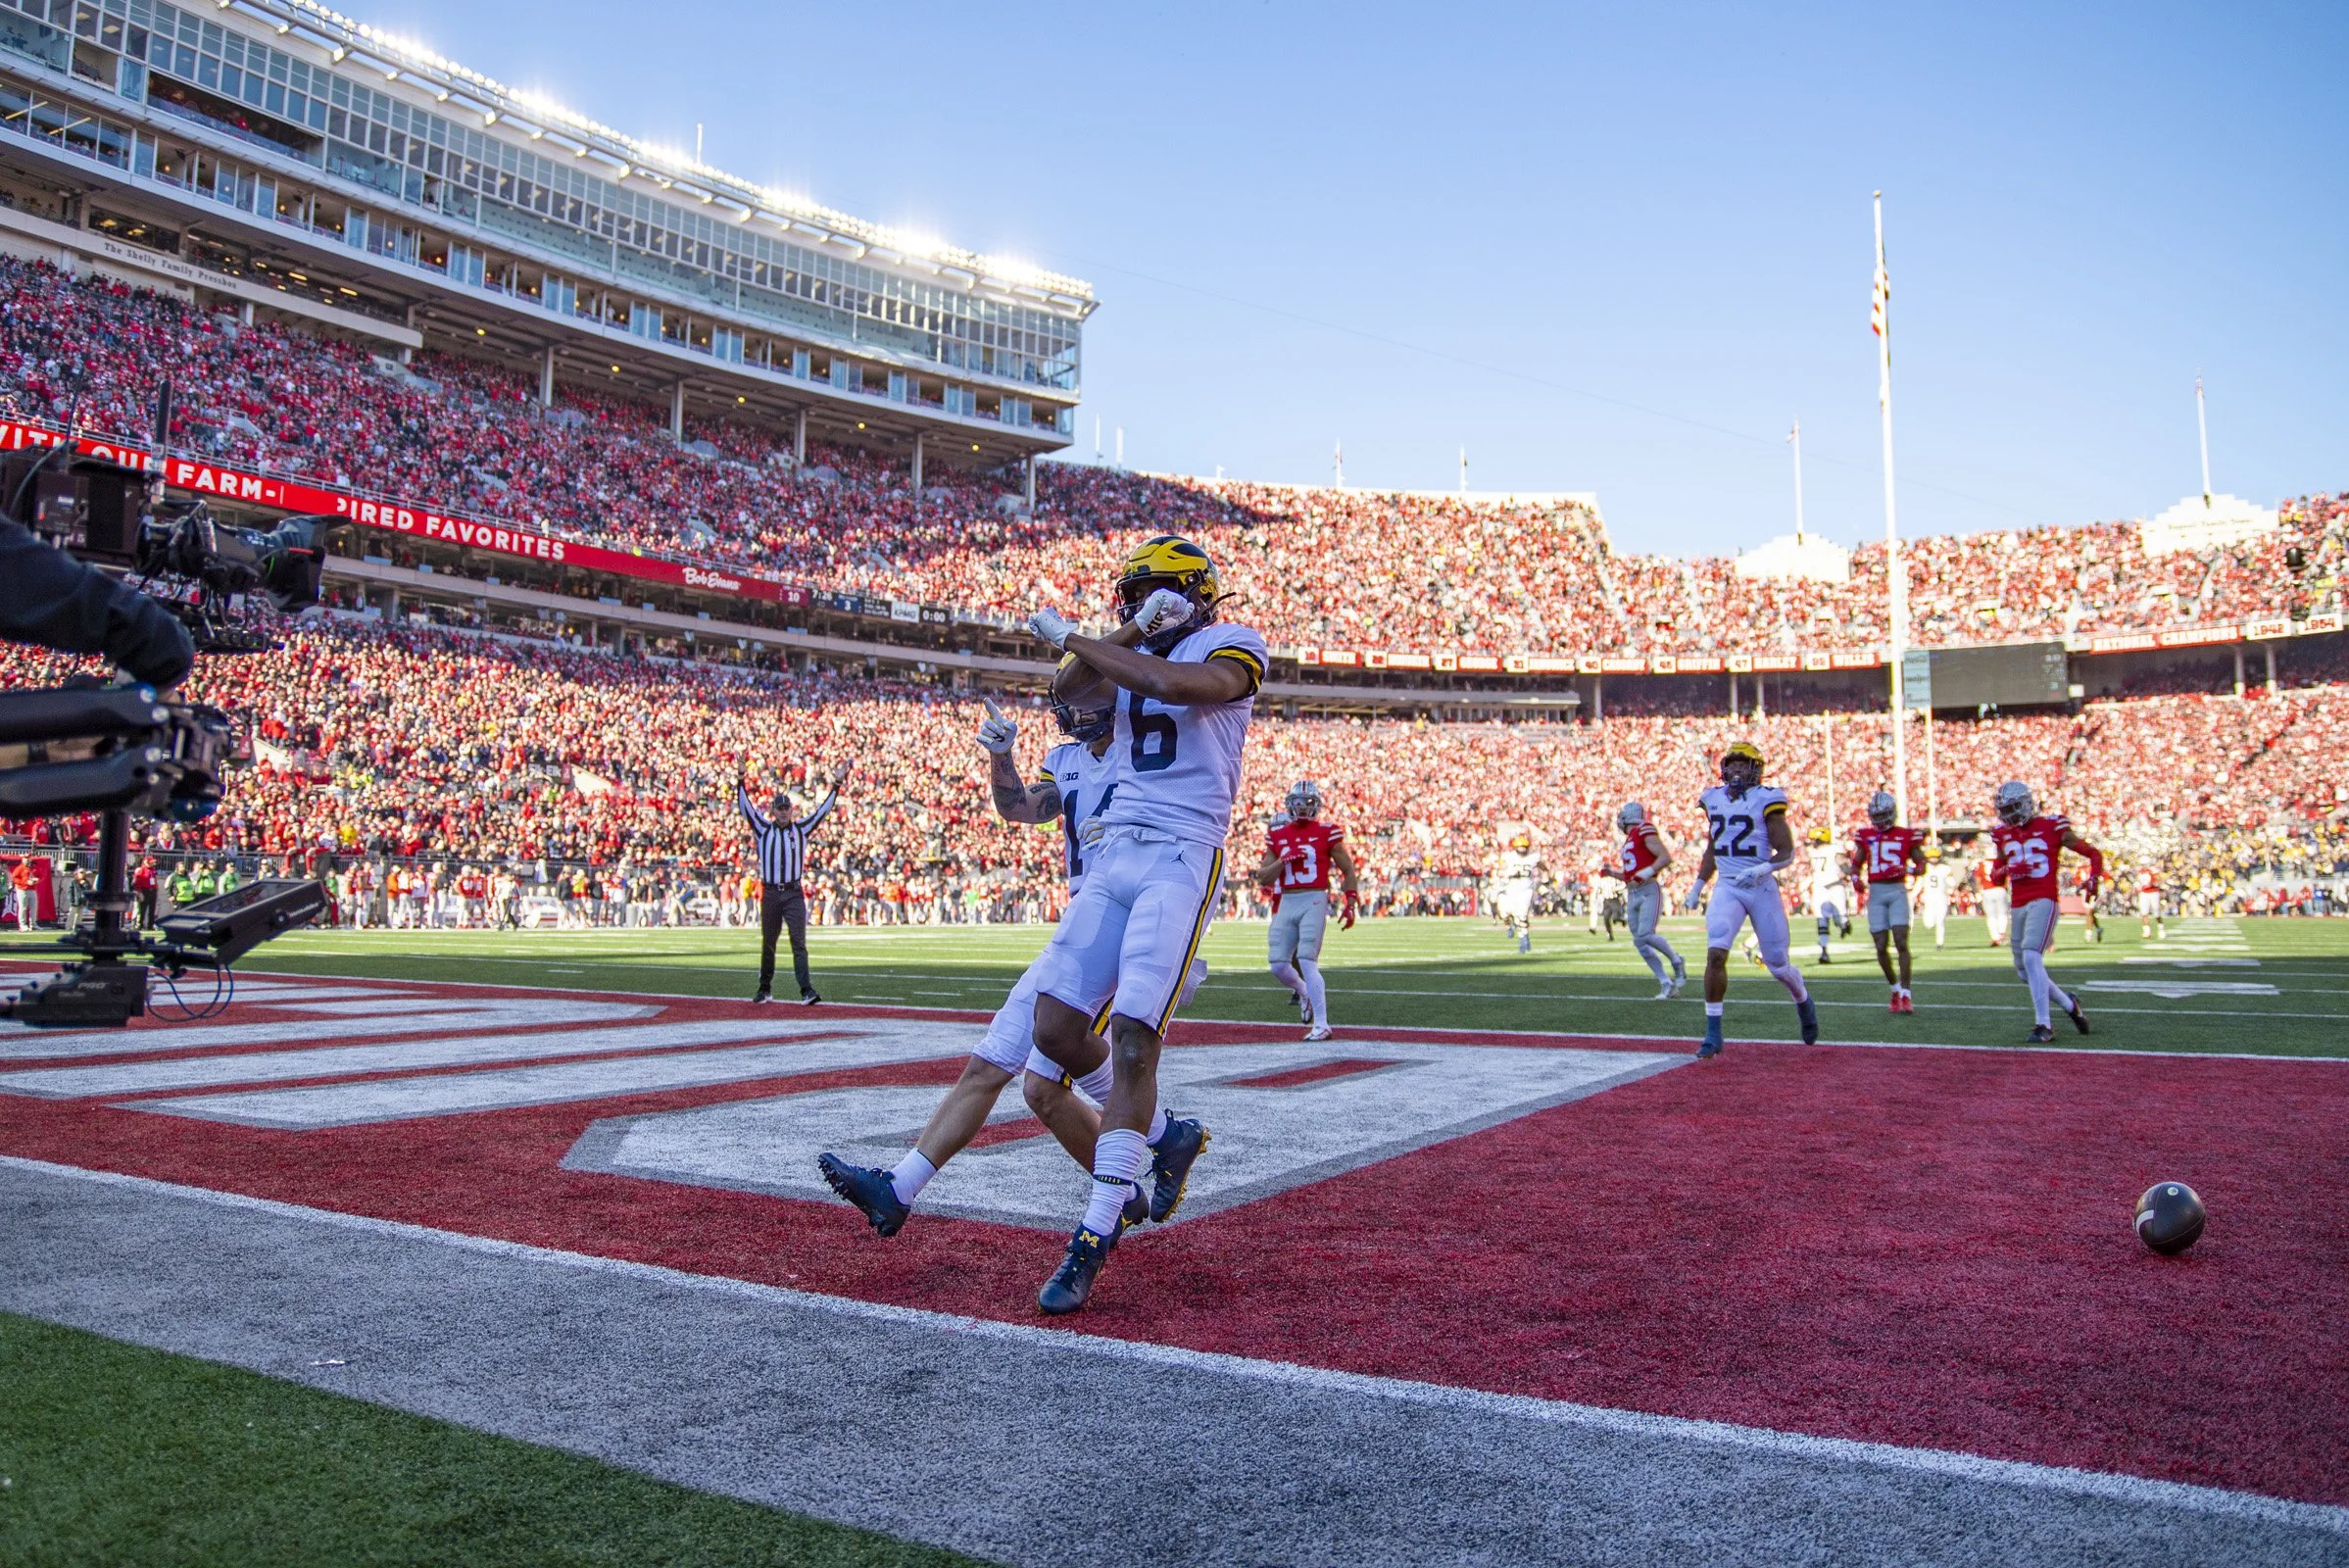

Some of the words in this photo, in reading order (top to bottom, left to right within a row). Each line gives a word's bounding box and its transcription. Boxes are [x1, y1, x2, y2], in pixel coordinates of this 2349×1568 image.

[104, 242, 122, 255] The
[127, 250, 157, 266] Shelly
[162, 260, 192, 277] Family
[198, 270, 237, 289] Pressbox
[425, 515, 565, 561] FAVORITES
[682, 566, 708, 585] Bob
[707, 571, 741, 591] Evans
[787, 590, 801, 604] 10
[894, 609, 917, 620] KPMG
[922, 609, 946, 623] 0:00
[2093, 633, 2156, 653] NATIONAL
[2160, 626, 2238, 647] CHAMPIONS
[2253, 623, 2284, 637] 1942
[1129, 690, 1178, 772] 6
[1710, 814, 1757, 857] 22
[1280, 844, 1318, 885] 13
[1869, 842, 1902, 874] 15
[2004, 838, 2049, 878] 26
[1079, 1230, 1100, 1249] M
